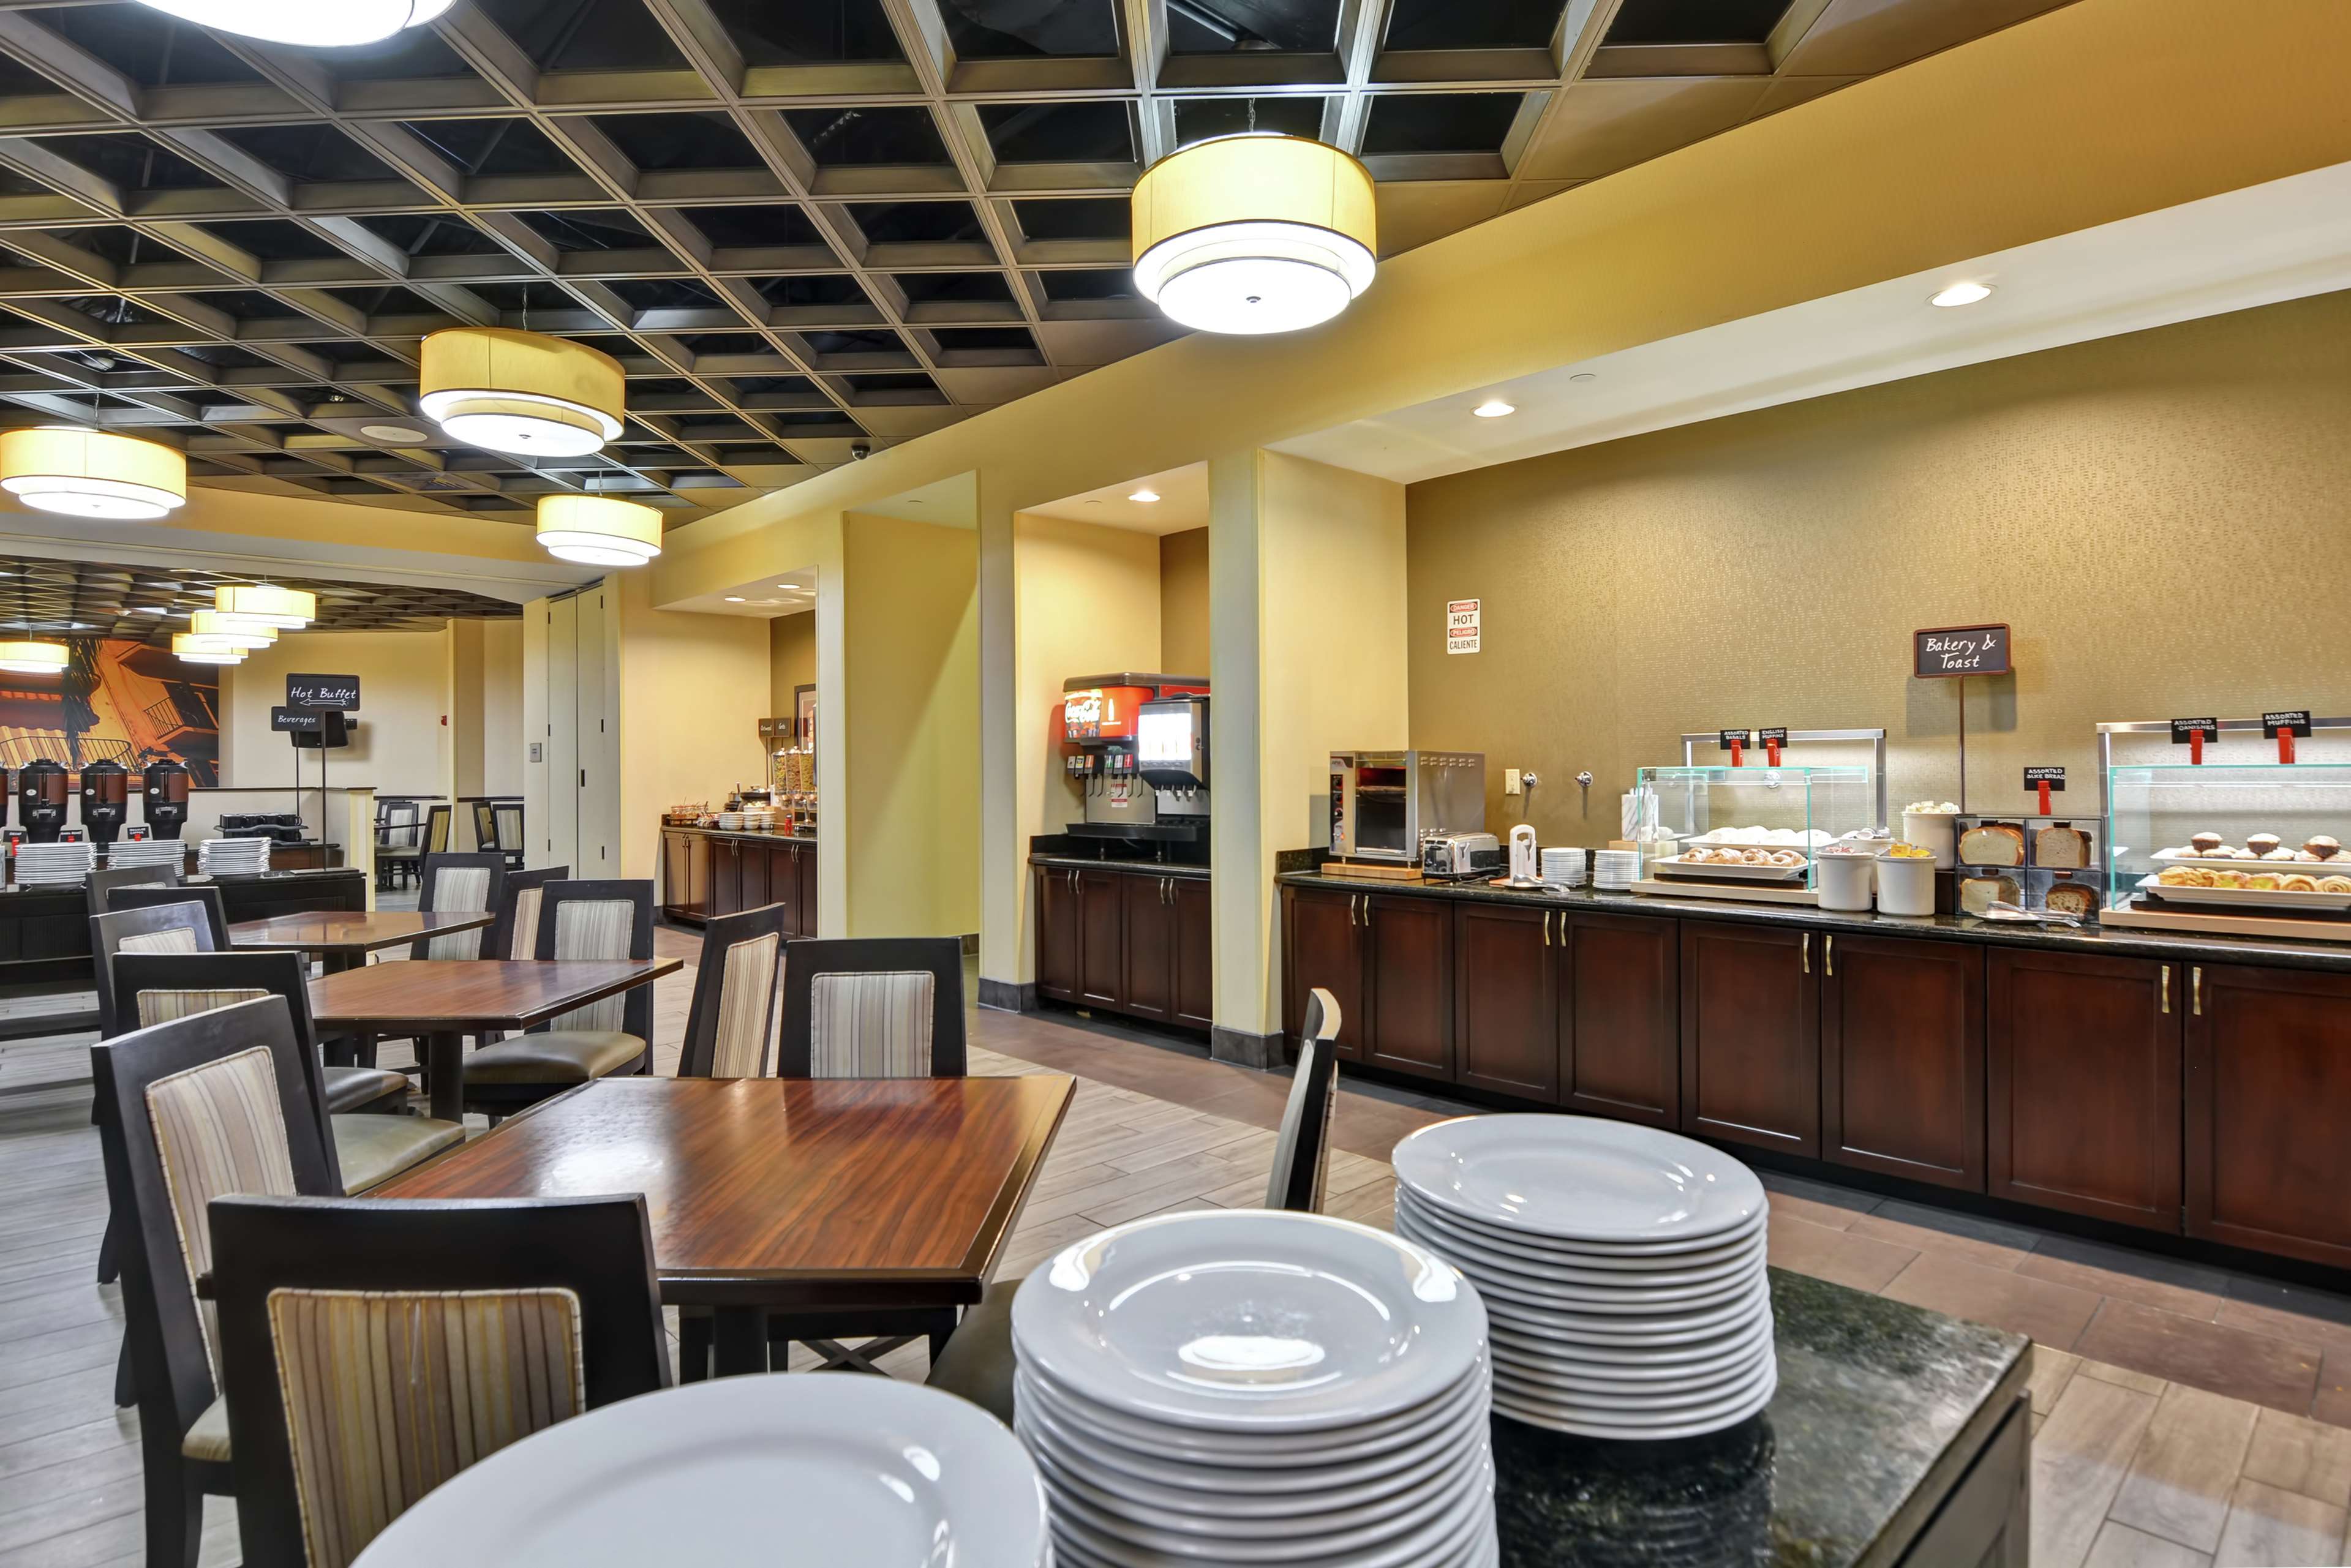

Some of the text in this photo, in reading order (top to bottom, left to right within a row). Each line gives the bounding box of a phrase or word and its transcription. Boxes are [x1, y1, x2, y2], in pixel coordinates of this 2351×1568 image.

[1453, 614, 1473, 625] HOT
[1450, 640, 1477, 650] CALIENTE
[1926, 637, 1976, 655] Bakery
[1940, 652, 1980, 669] Toast
[290, 687, 356, 699] Hot Buffet
[277, 715, 316, 726] Beverages
